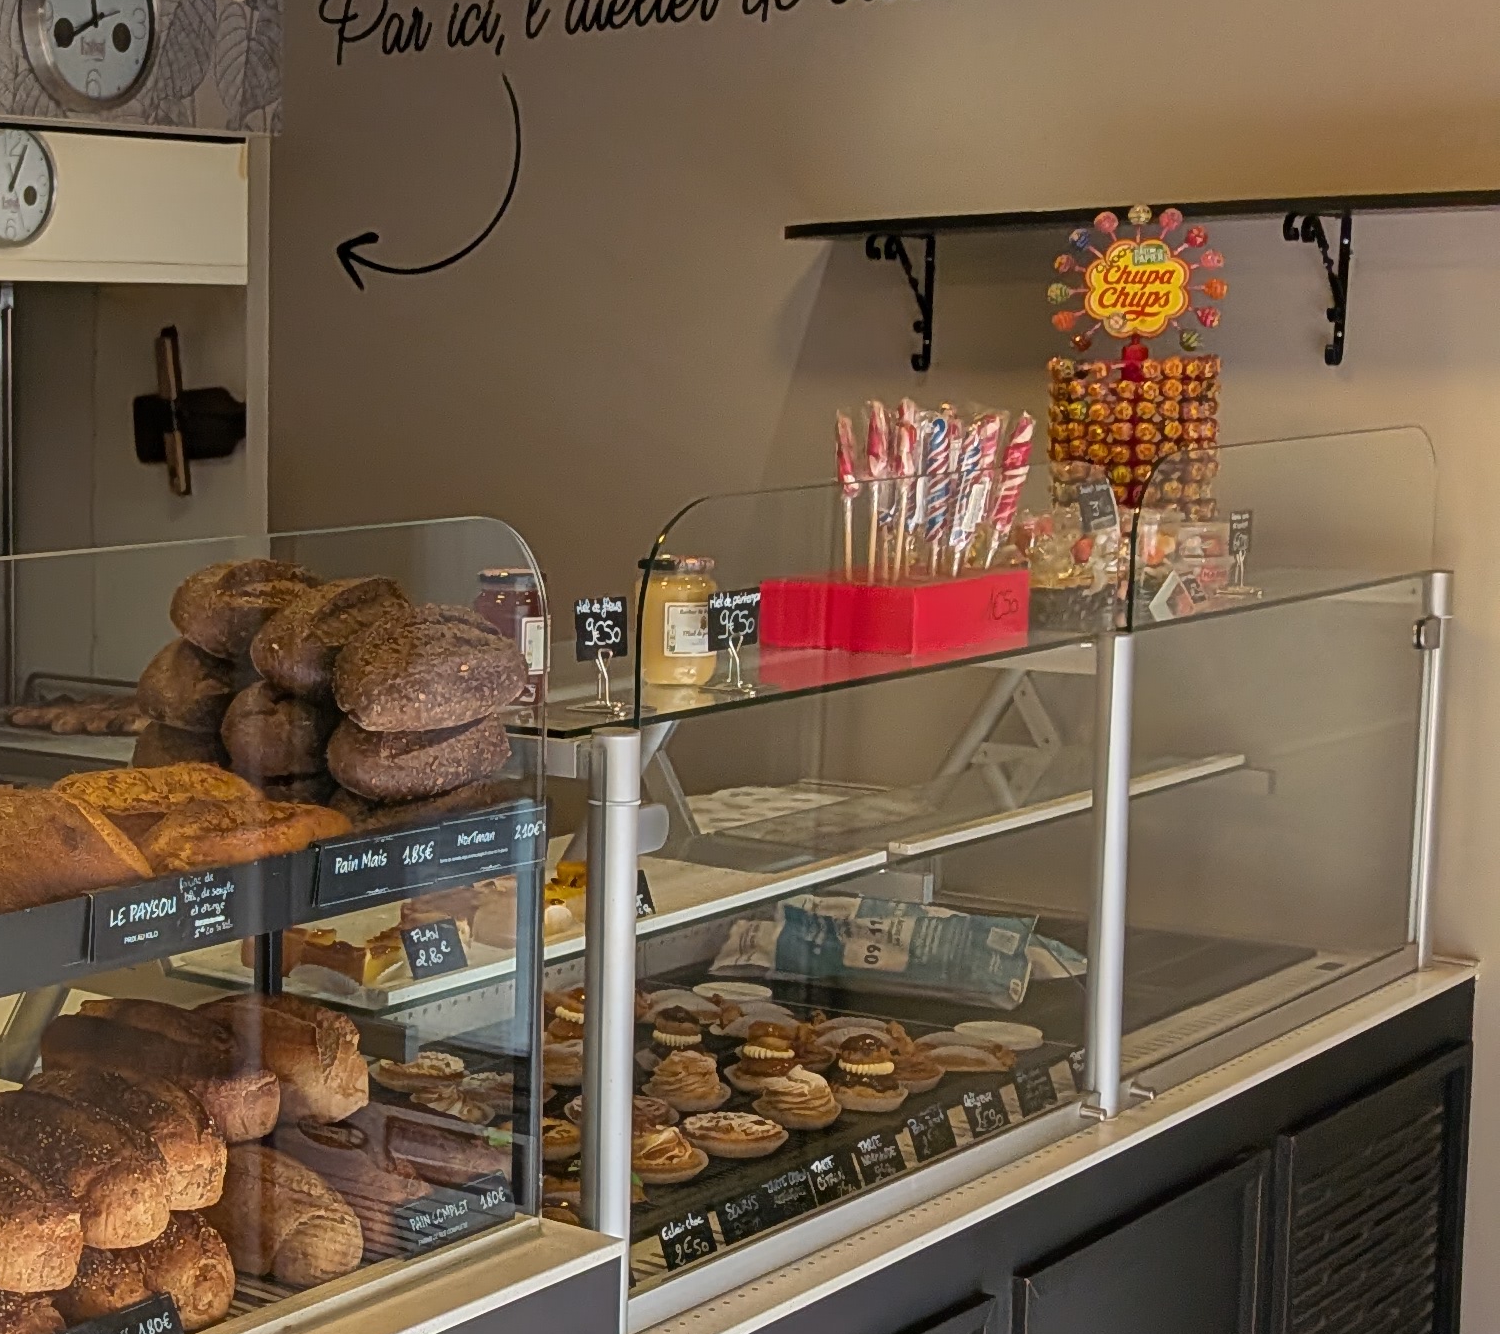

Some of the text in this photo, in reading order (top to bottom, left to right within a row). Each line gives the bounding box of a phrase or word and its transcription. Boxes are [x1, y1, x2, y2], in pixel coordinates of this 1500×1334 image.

[1102, 264, 1176, 291] Chupa
[1097, 286, 1172, 317] Chups
[584, 617, 622, 646] 9€50
[717, 609, 756, 640] 9€50
[334, 853, 358, 875] Pain
[360, 848, 388, 870] Mais
[109, 896, 177, 928] LE PAYSOU
[410, 923, 440, 944] FLAN
[408, 1198, 469, 1232] PAIN COMPLET
